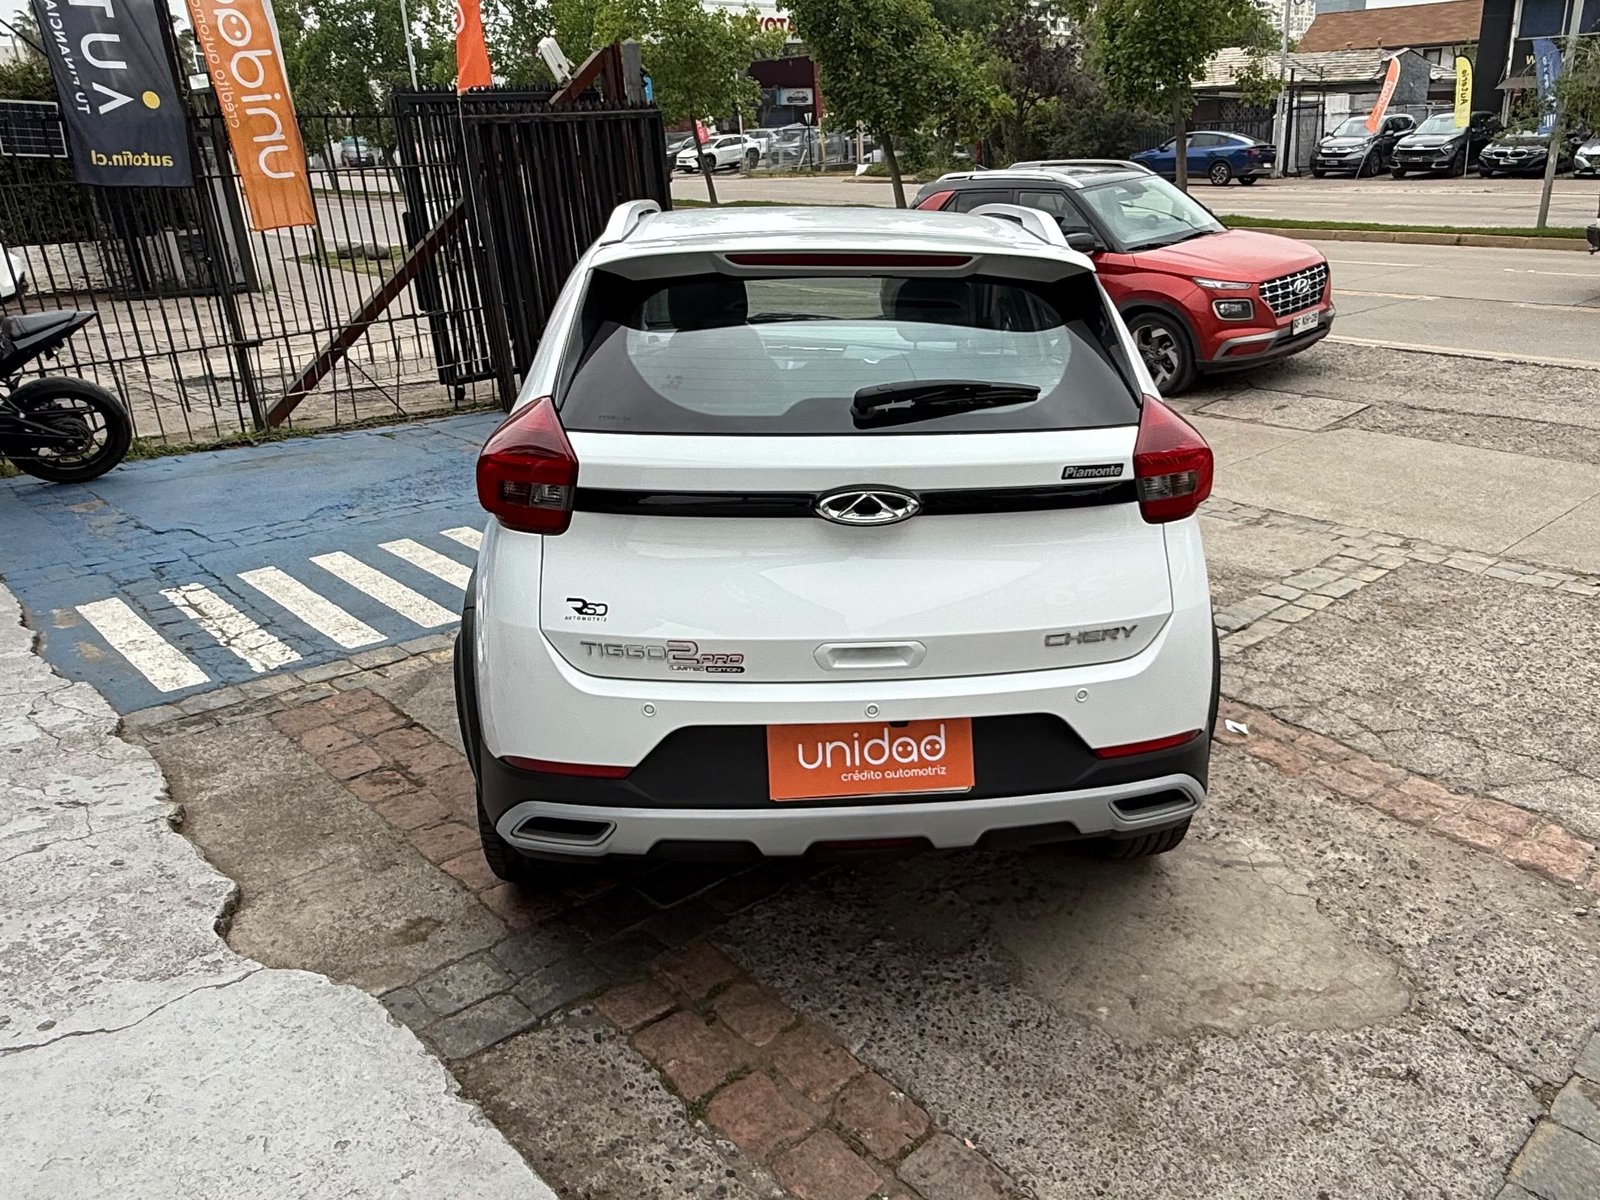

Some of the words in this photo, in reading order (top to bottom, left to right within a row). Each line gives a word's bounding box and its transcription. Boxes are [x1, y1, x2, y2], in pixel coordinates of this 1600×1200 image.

[1064, 466, 1122, 478] Piamonte
[1044, 625, 1138, 647] CHERY
[797, 723, 946, 769] unidad
[841, 769, 882, 782] crédito
[885, 765, 946, 780] automotriz
